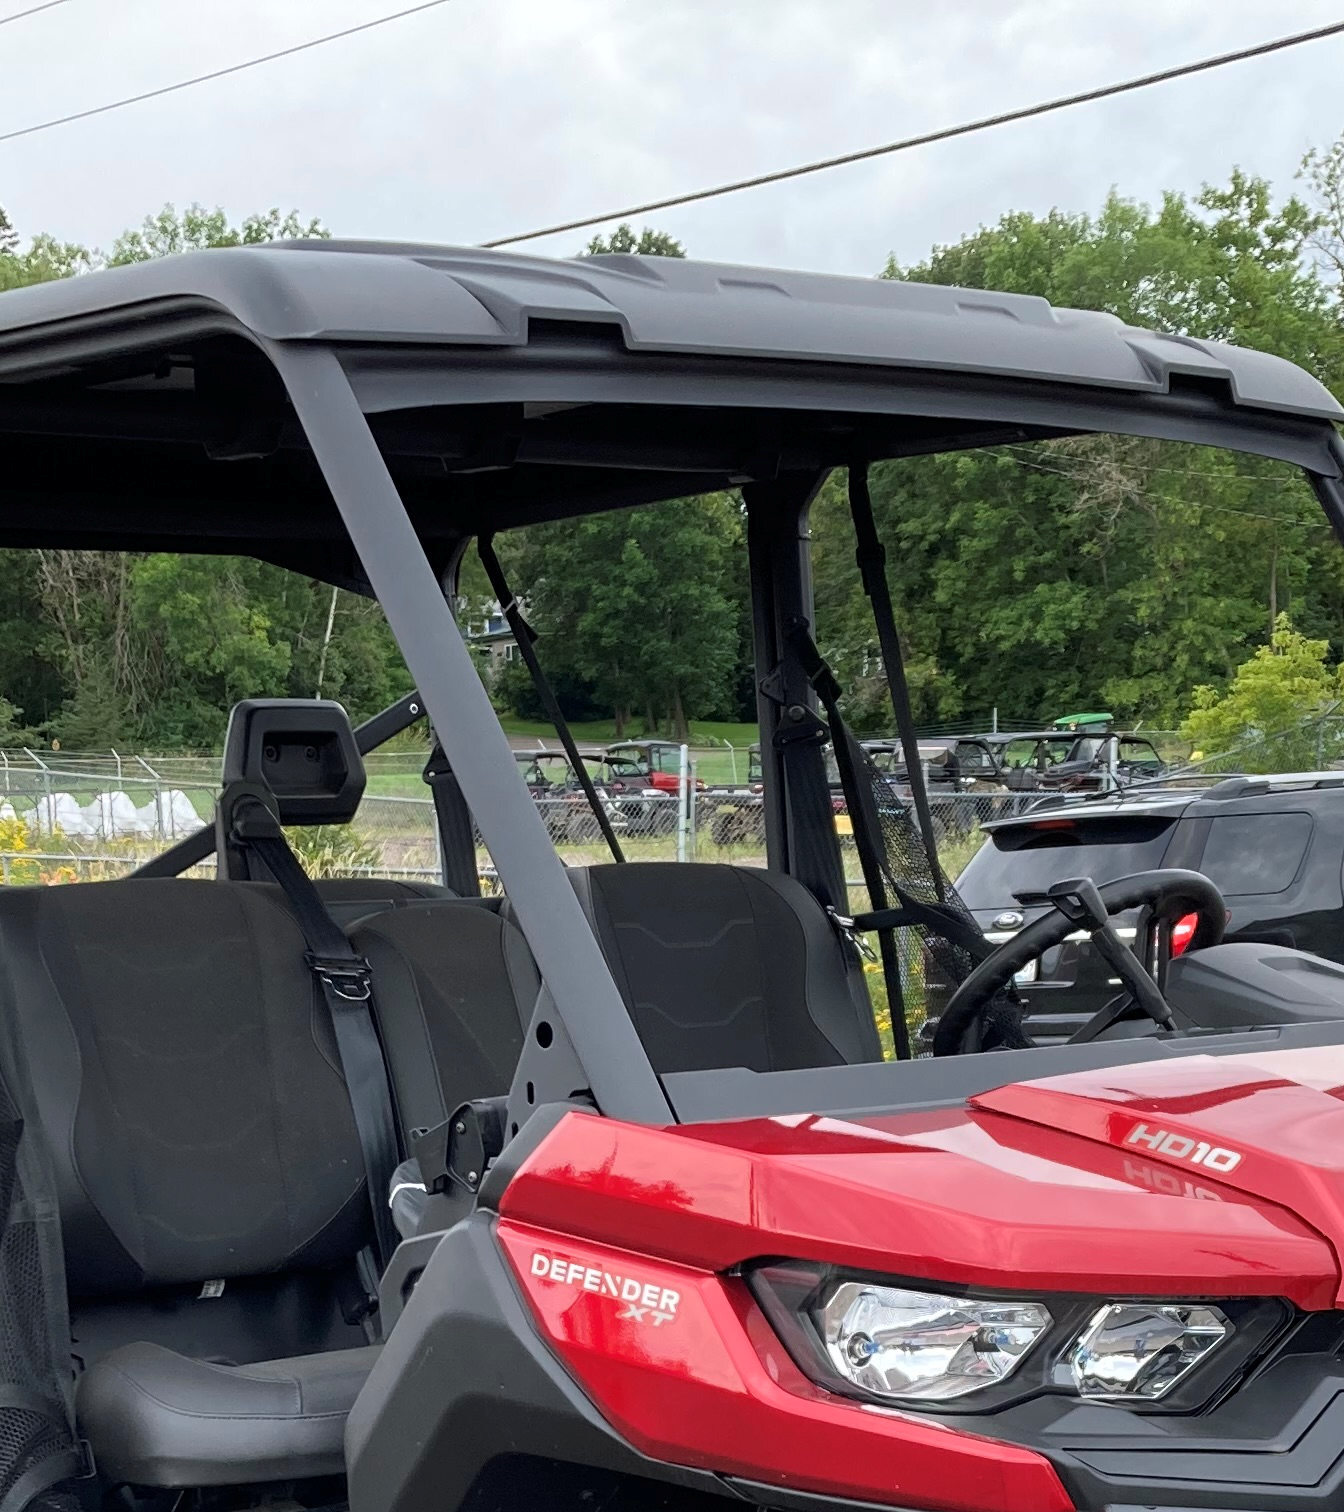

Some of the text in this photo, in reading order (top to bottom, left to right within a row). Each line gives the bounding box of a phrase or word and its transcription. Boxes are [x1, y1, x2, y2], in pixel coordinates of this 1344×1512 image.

[1128, 1123, 1243, 1173] HD10
[530, 1253, 681, 1313] DEFENDER
[620, 1303, 675, 1327] XT
